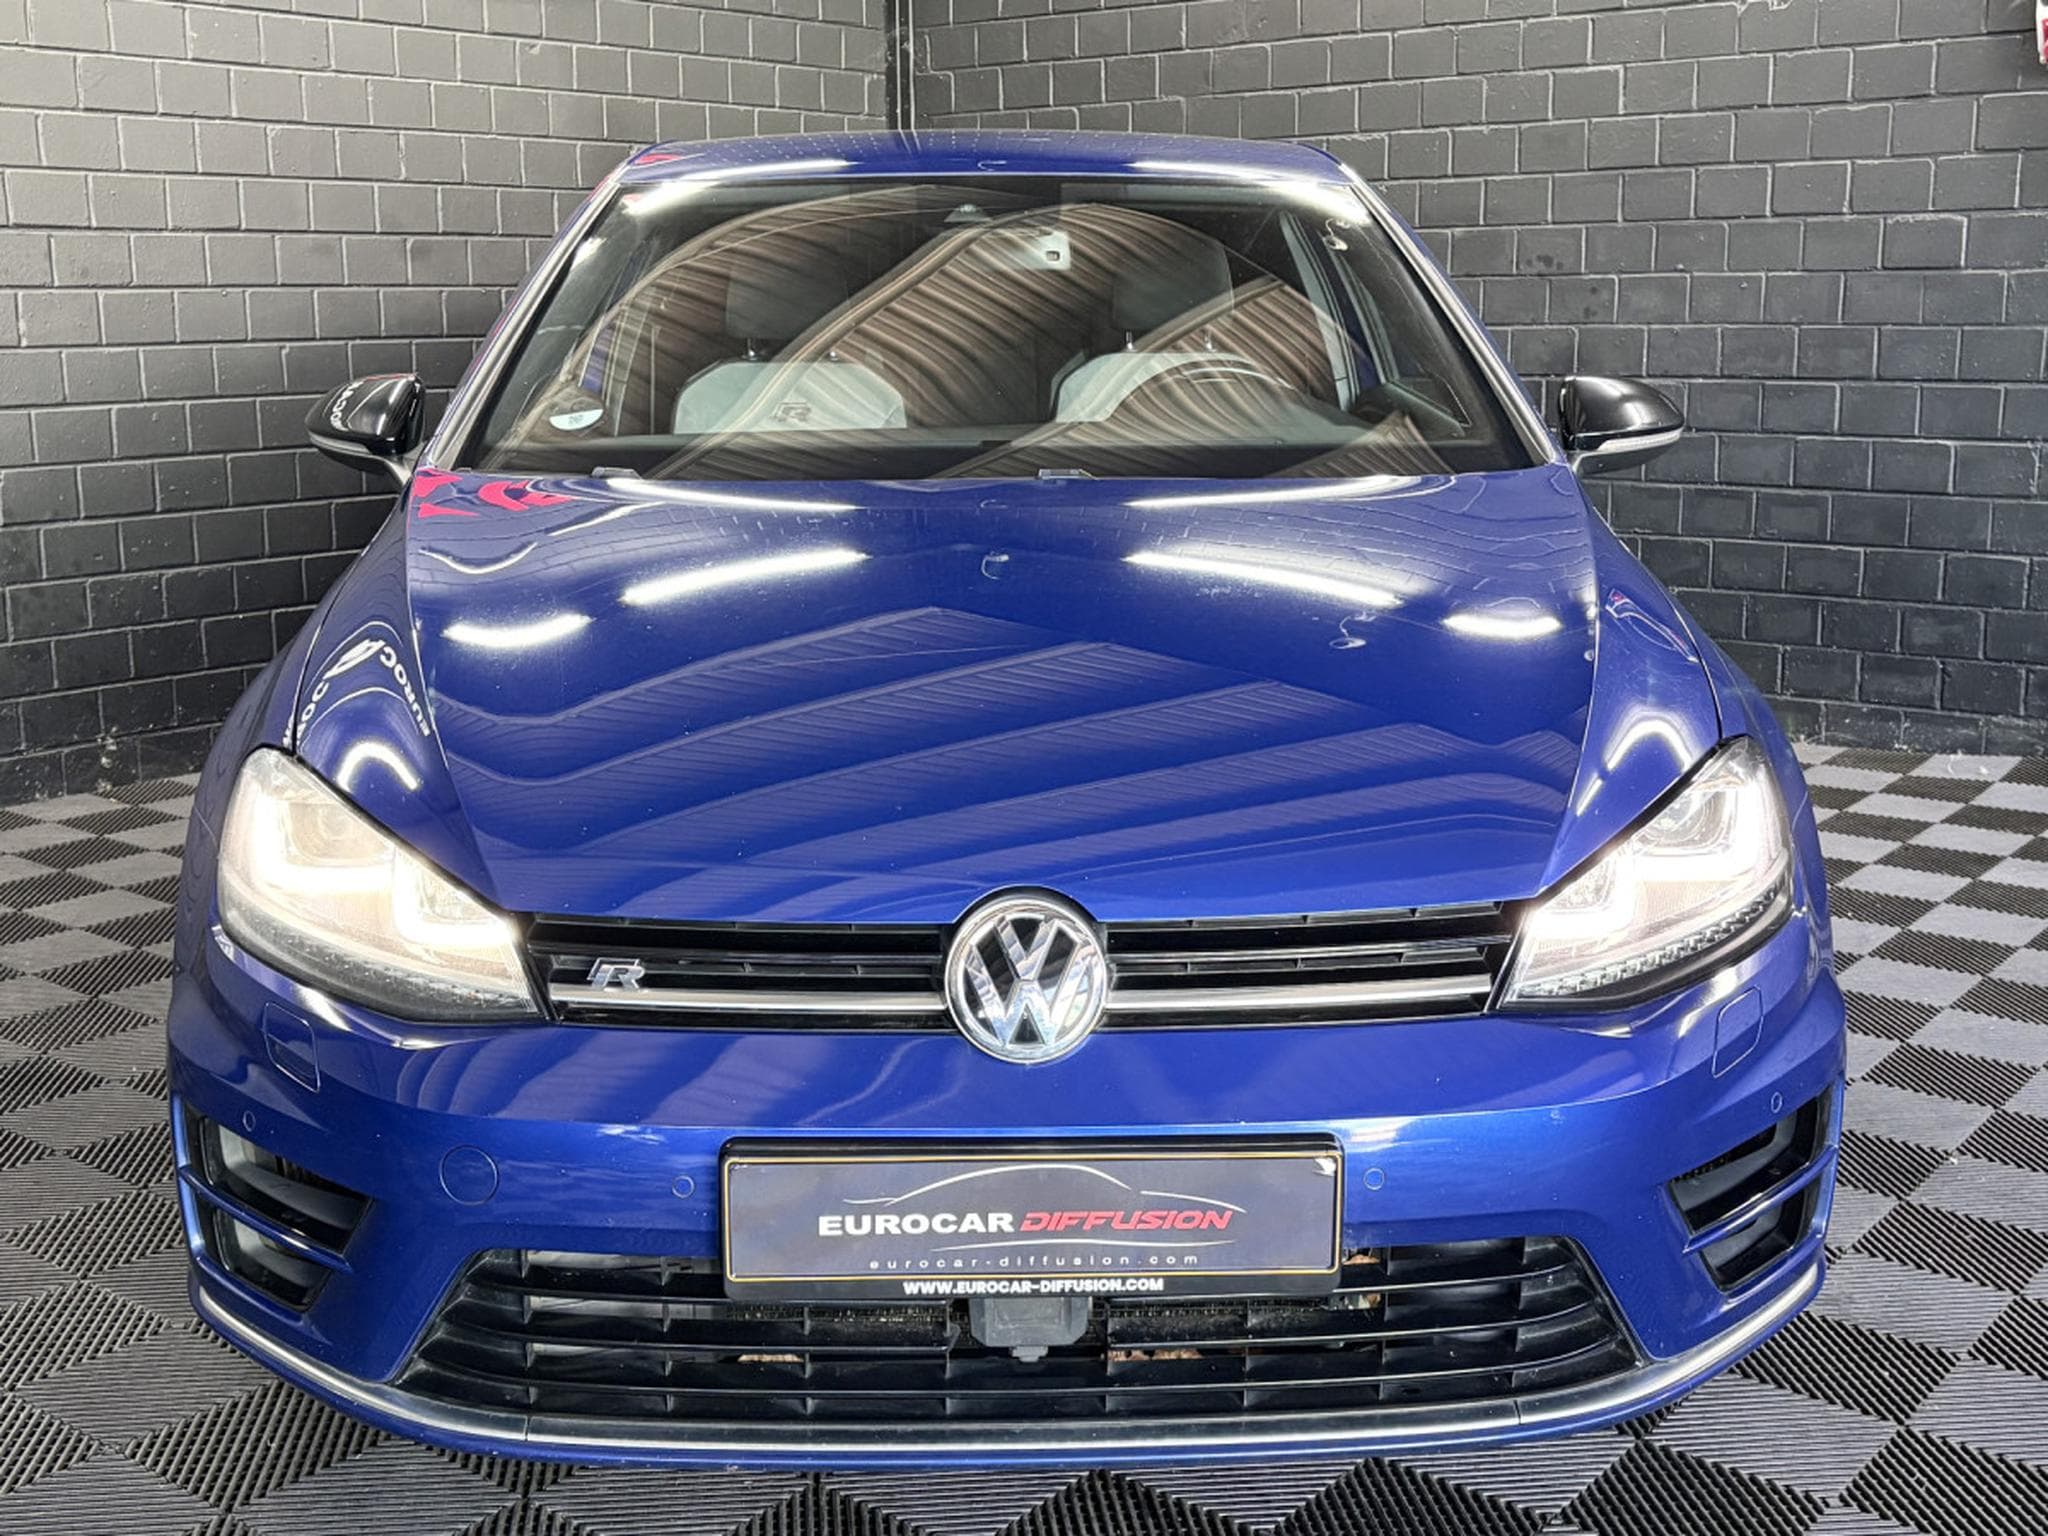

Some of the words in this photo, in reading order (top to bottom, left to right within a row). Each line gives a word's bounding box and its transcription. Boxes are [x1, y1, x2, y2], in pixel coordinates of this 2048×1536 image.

[588, 958, 647, 992] R
[969, 914, 1095, 1046] VW
[818, 1212, 1013, 1235] EUROCAR
[1020, 1210, 1232, 1232] DIFFUSION
[869, 1255, 1199, 1269] eurocar-diffusion.com
[903, 1278, 1164, 1295] WWW.EUROCAR-DIFFUSION.COM
